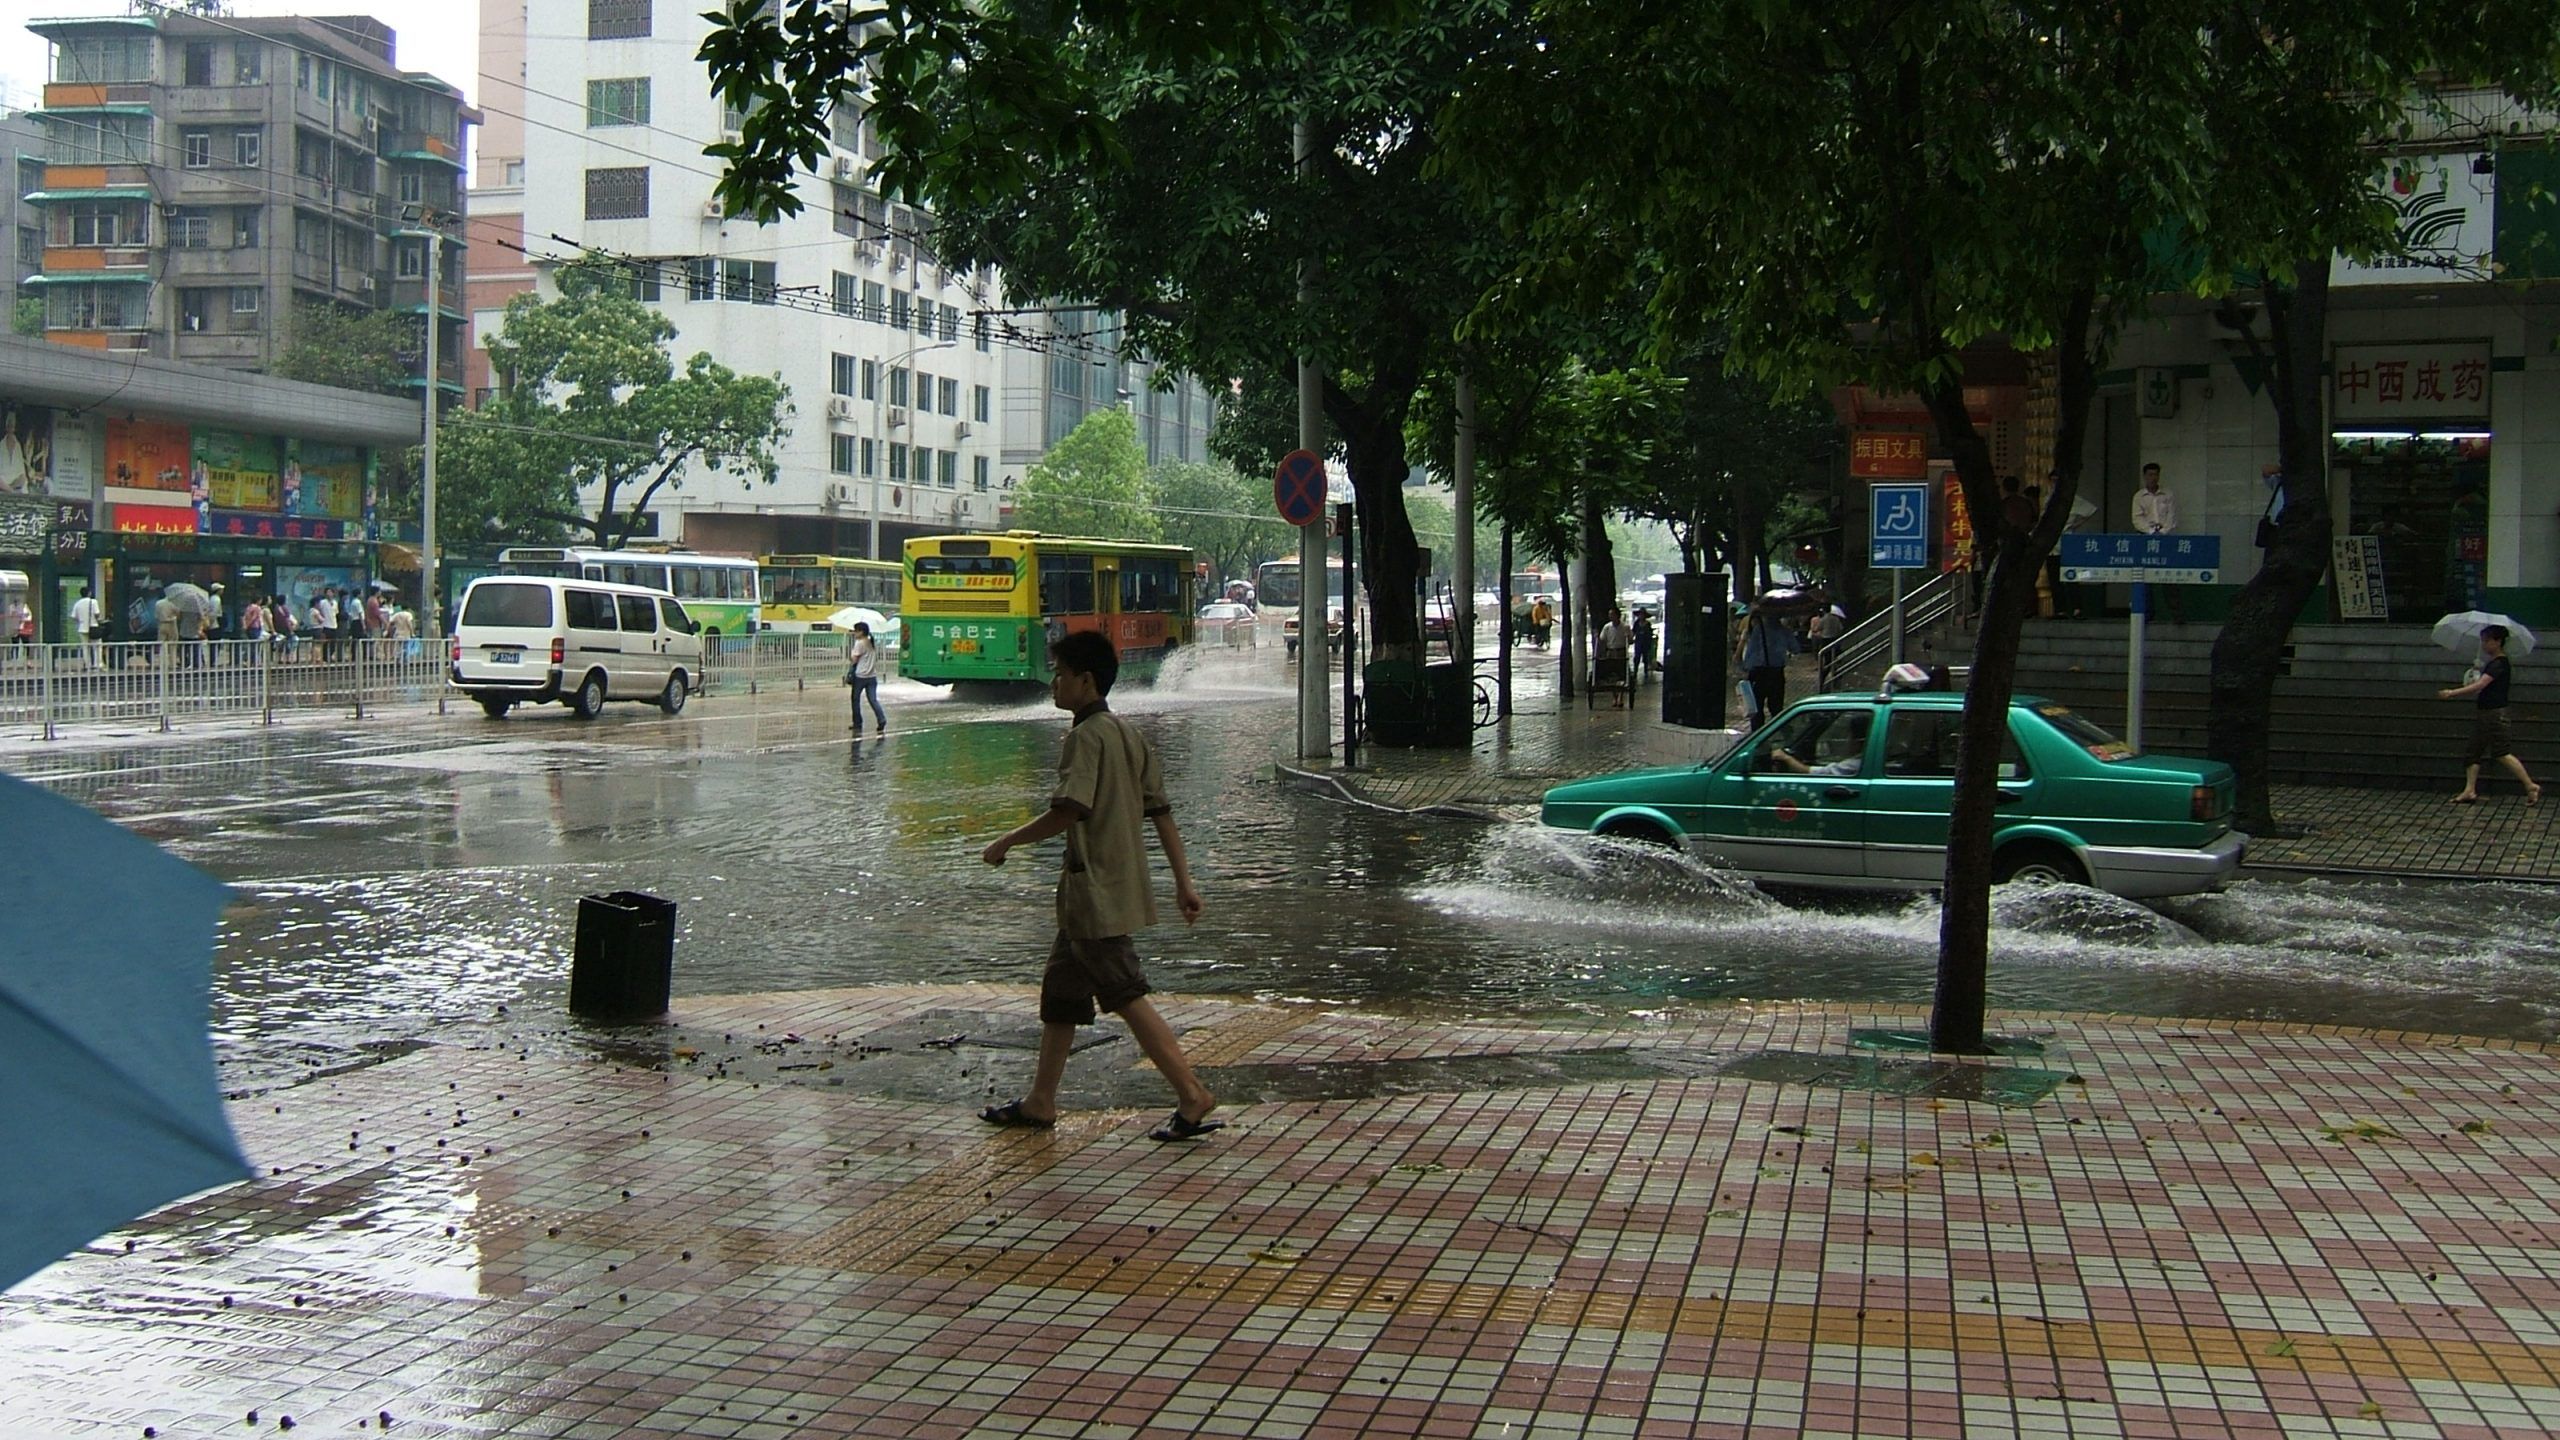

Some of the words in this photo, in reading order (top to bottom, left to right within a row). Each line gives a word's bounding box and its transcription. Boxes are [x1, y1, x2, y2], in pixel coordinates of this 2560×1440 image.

[2337, 359, 2487, 404] 中西成药
[1855, 438, 1924, 459] 振国文具
[60, 505, 89, 525] 第八
[60, 531, 88, 549] 分店
[2085, 538, 2192, 554] 执信南路
[931, 625, 996, 639] 马会巴士
